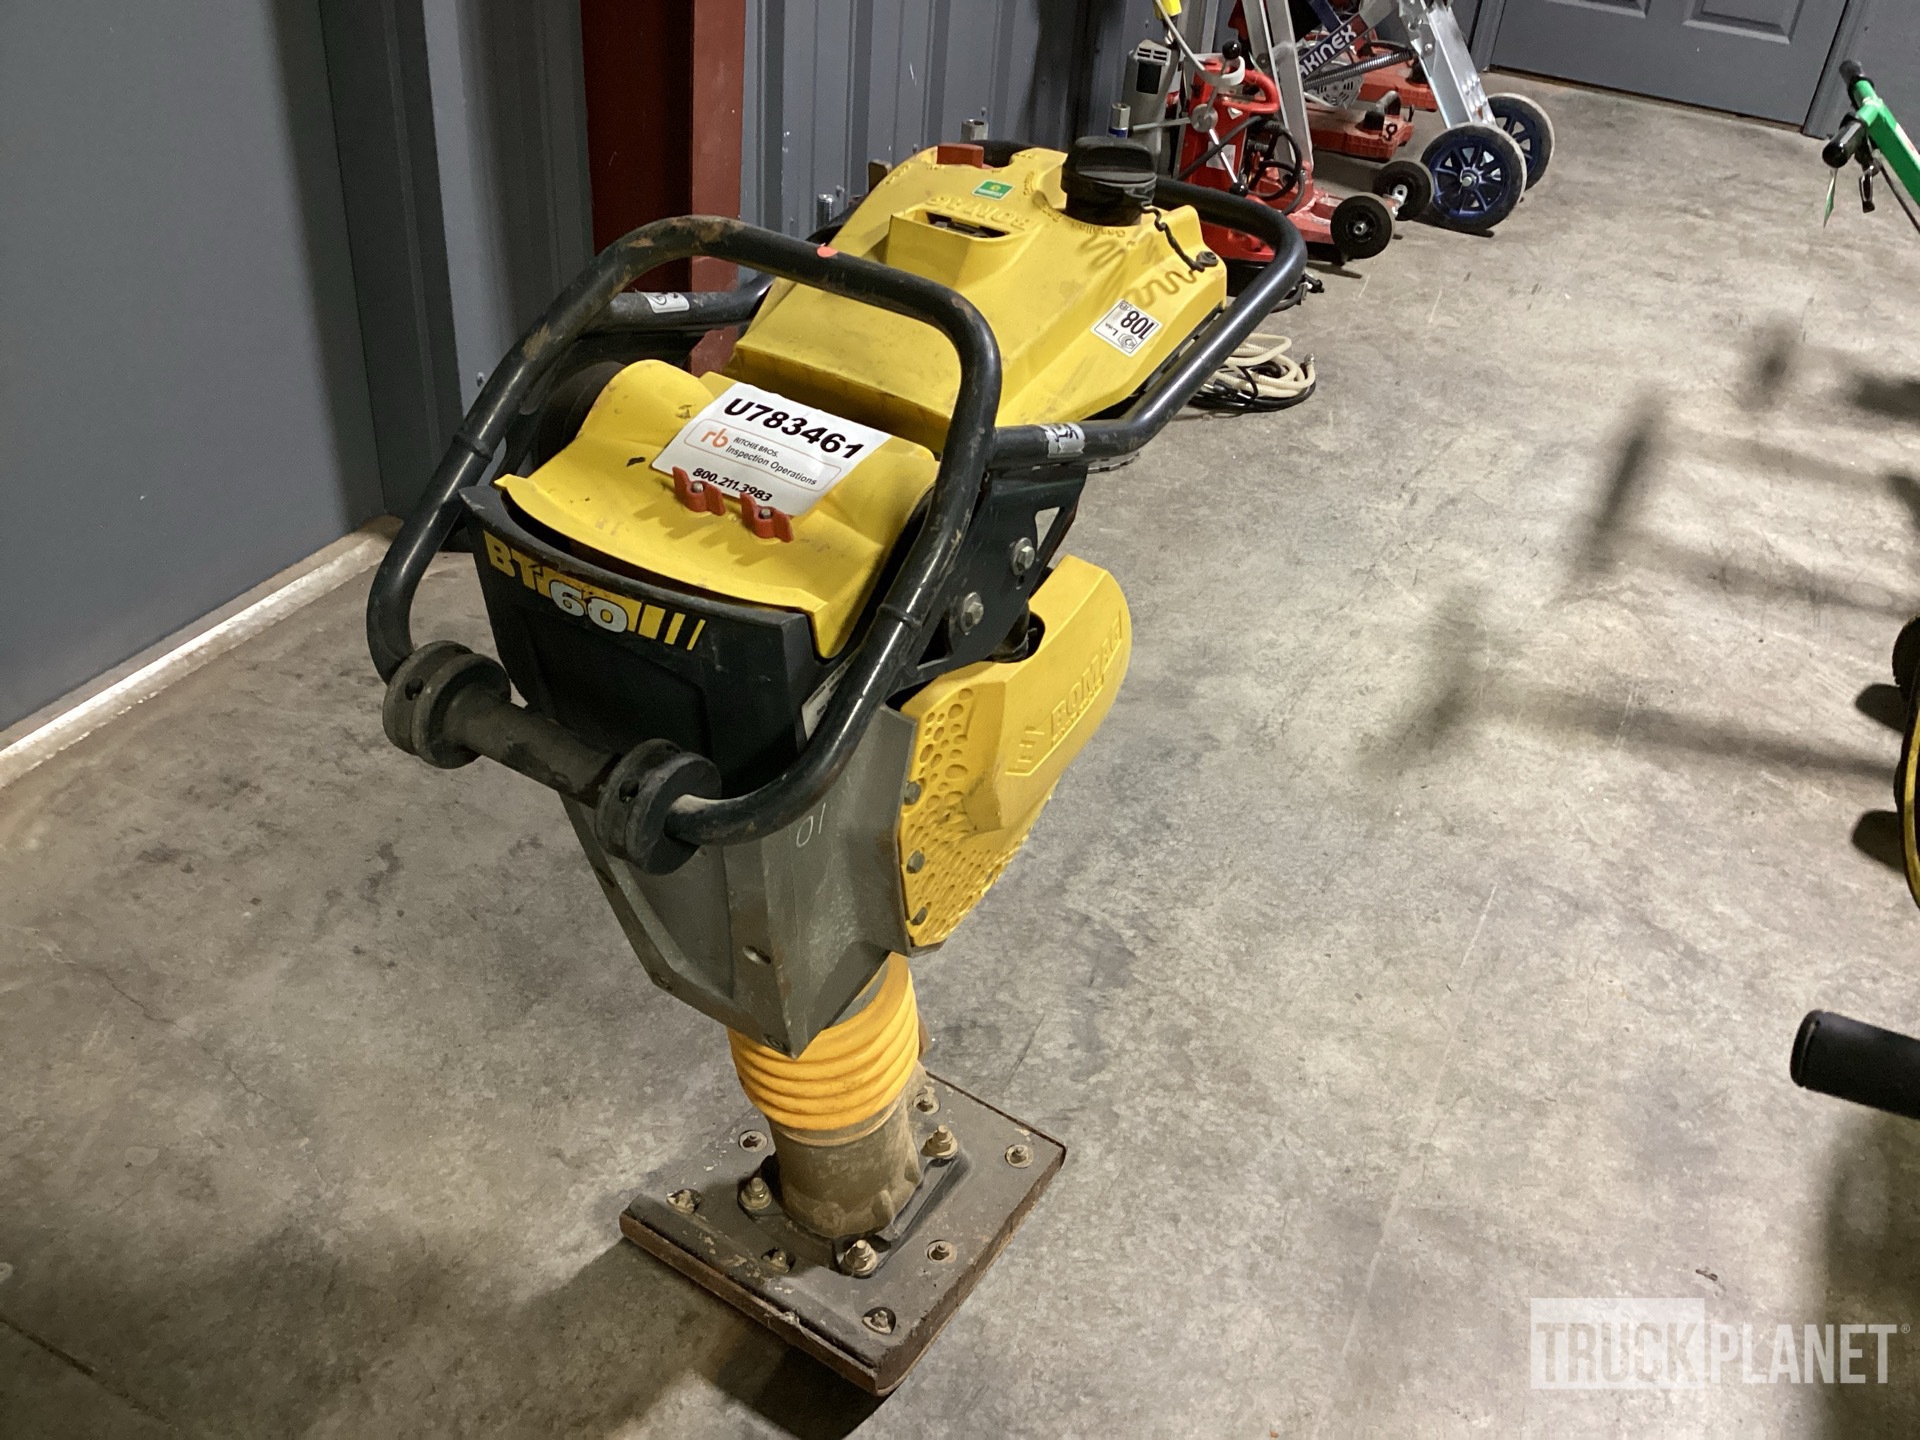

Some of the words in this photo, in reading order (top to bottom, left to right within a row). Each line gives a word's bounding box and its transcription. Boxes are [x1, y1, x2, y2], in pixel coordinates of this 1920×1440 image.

[1300, 24, 1357, 76] AKINEX
[1120, 310, 1155, 340] 108
[724, 398, 865, 459] U783461
[733, 437, 760, 450] RITCHIE
[759, 445, 779, 458] BROS.
[692, 467, 773, 502] 800.211.3983
[726, 445, 769, 466] Inspection
[770, 461, 818, 486] Operations
[550, 580, 629, 633] 60
